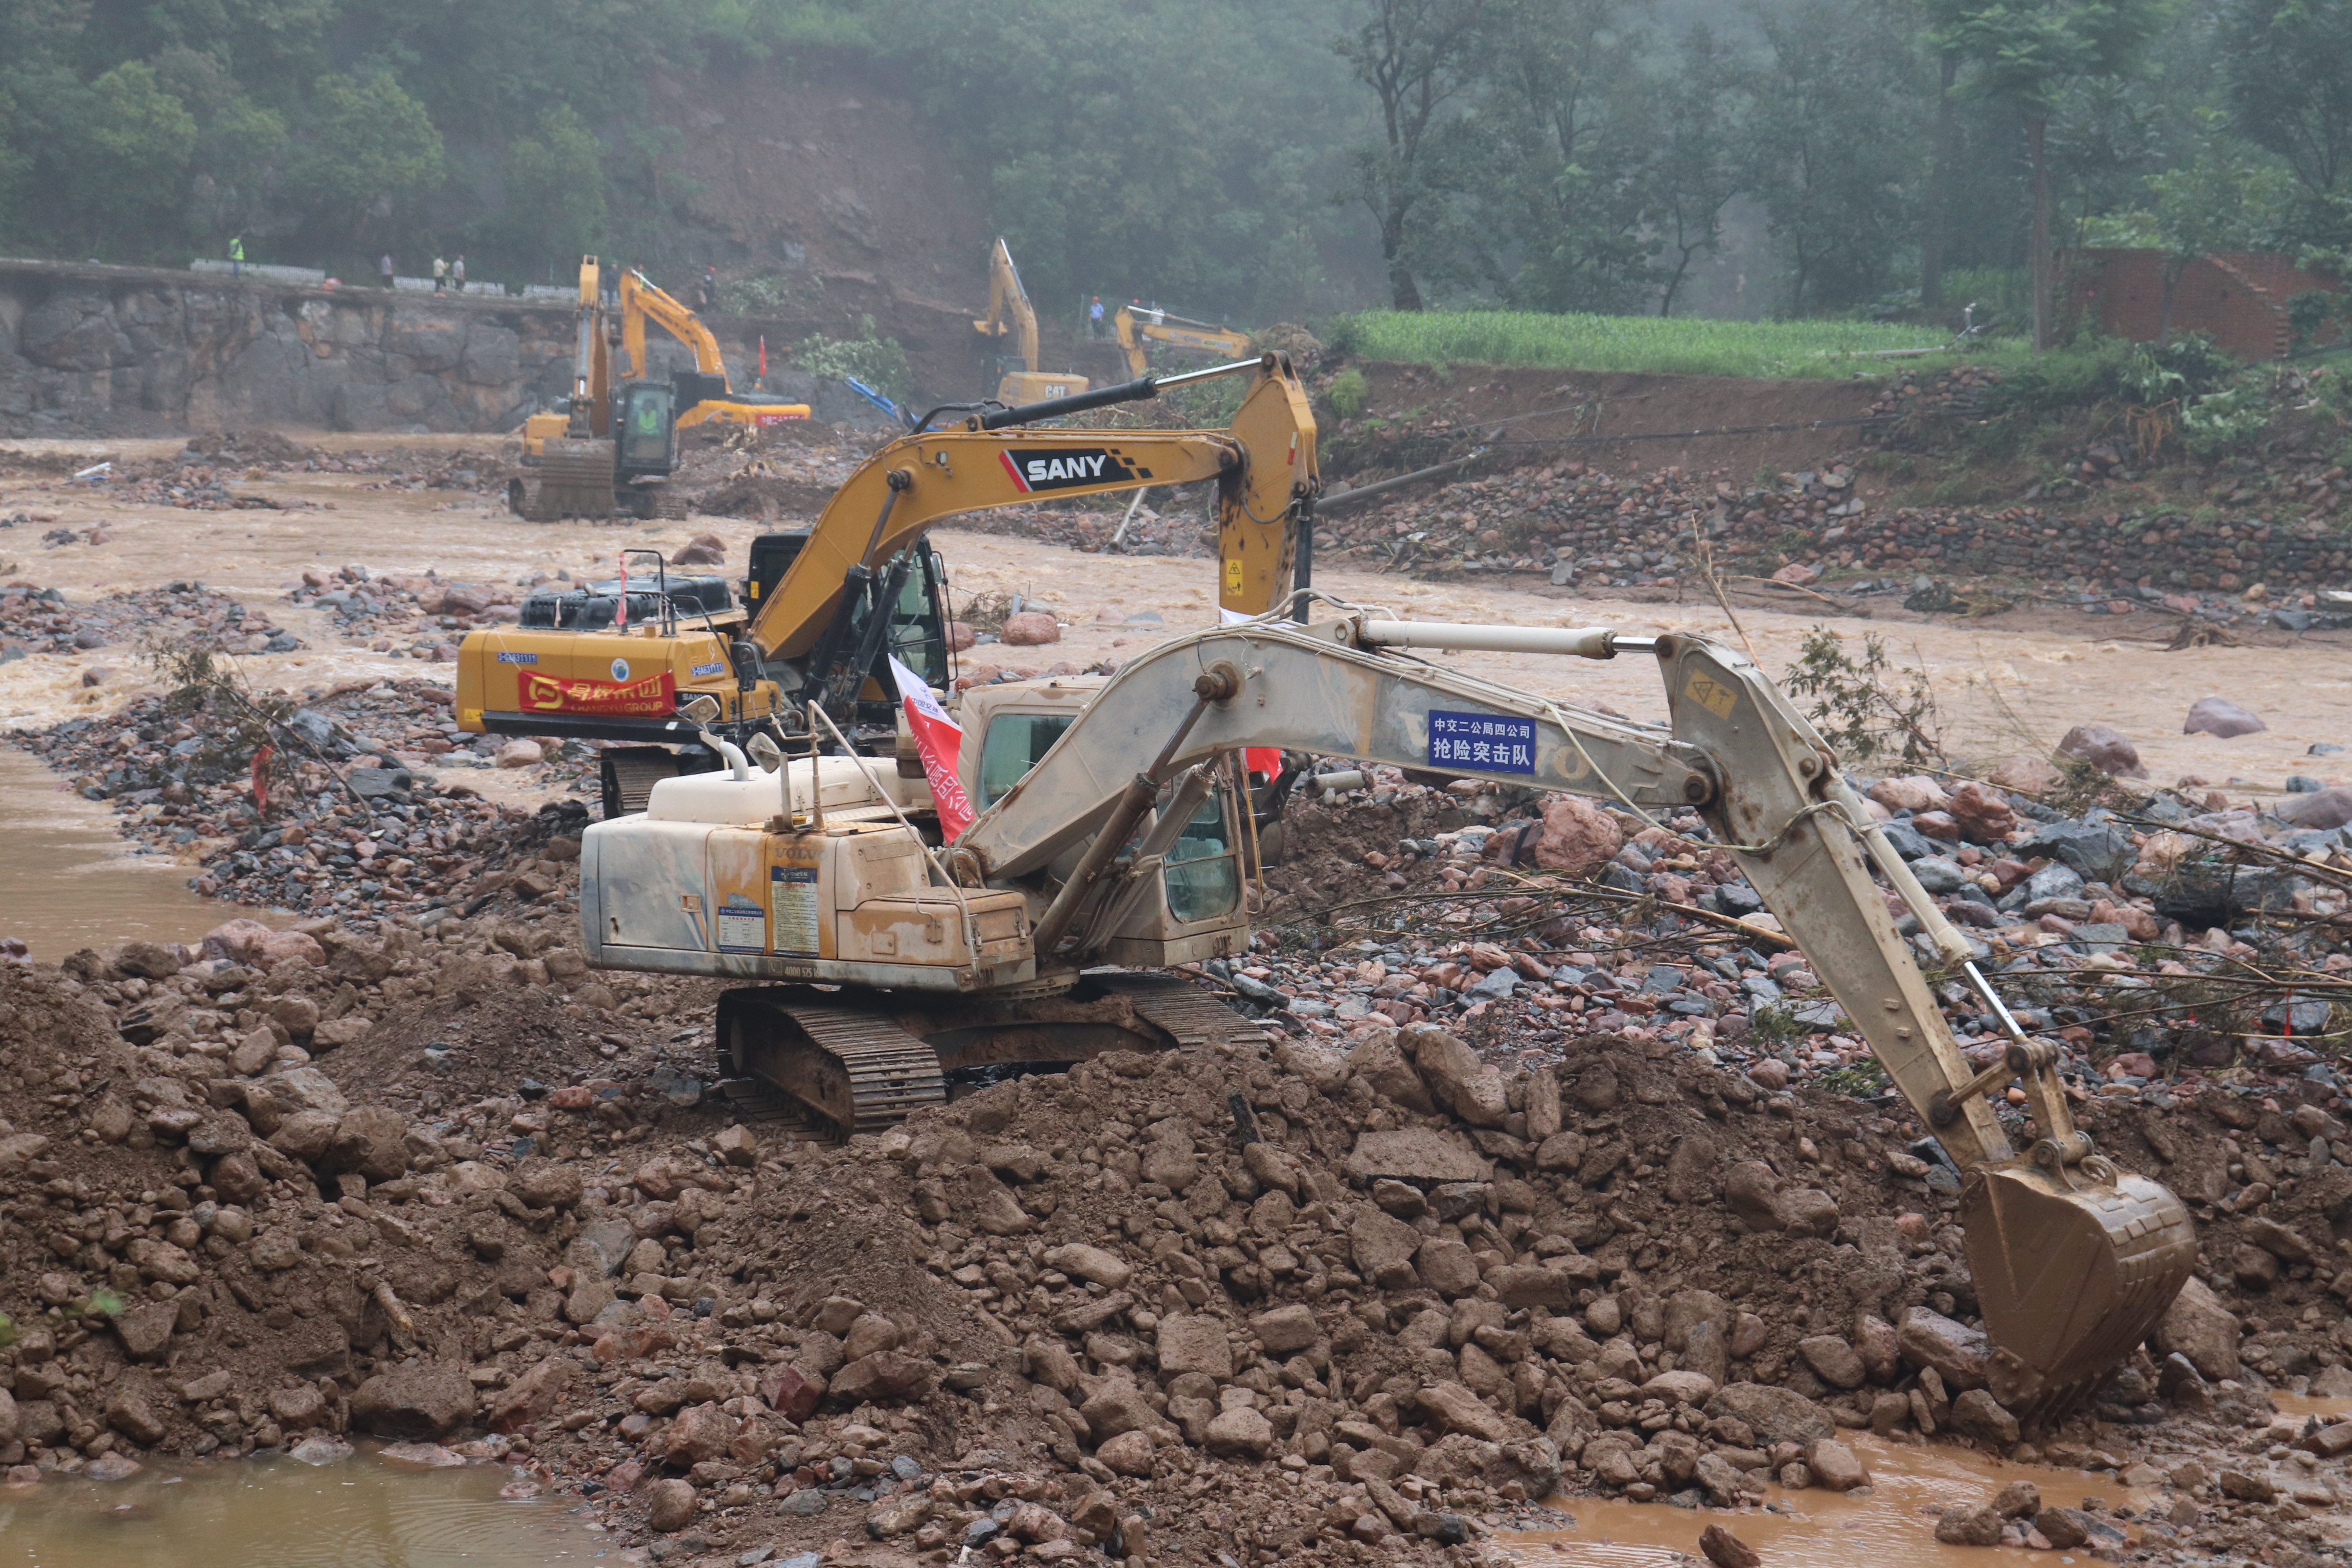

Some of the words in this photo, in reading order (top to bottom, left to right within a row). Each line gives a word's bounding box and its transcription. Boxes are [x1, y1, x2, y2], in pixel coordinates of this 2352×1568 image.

[1045, 385, 1065, 399] CAT
[1027, 455, 1106, 481] SANY
[623, 701, 663, 712] GROUP
[911, 697, 939, 713] 中国交建
[1435, 718, 1530, 739] 中交二公局四公司
[1434, 738, 1530, 766] 抢险突击队
[775, 848, 828, 861] VOLVO
[785, 966, 800, 977] 4000
[802, 967, 812, 978] 525
